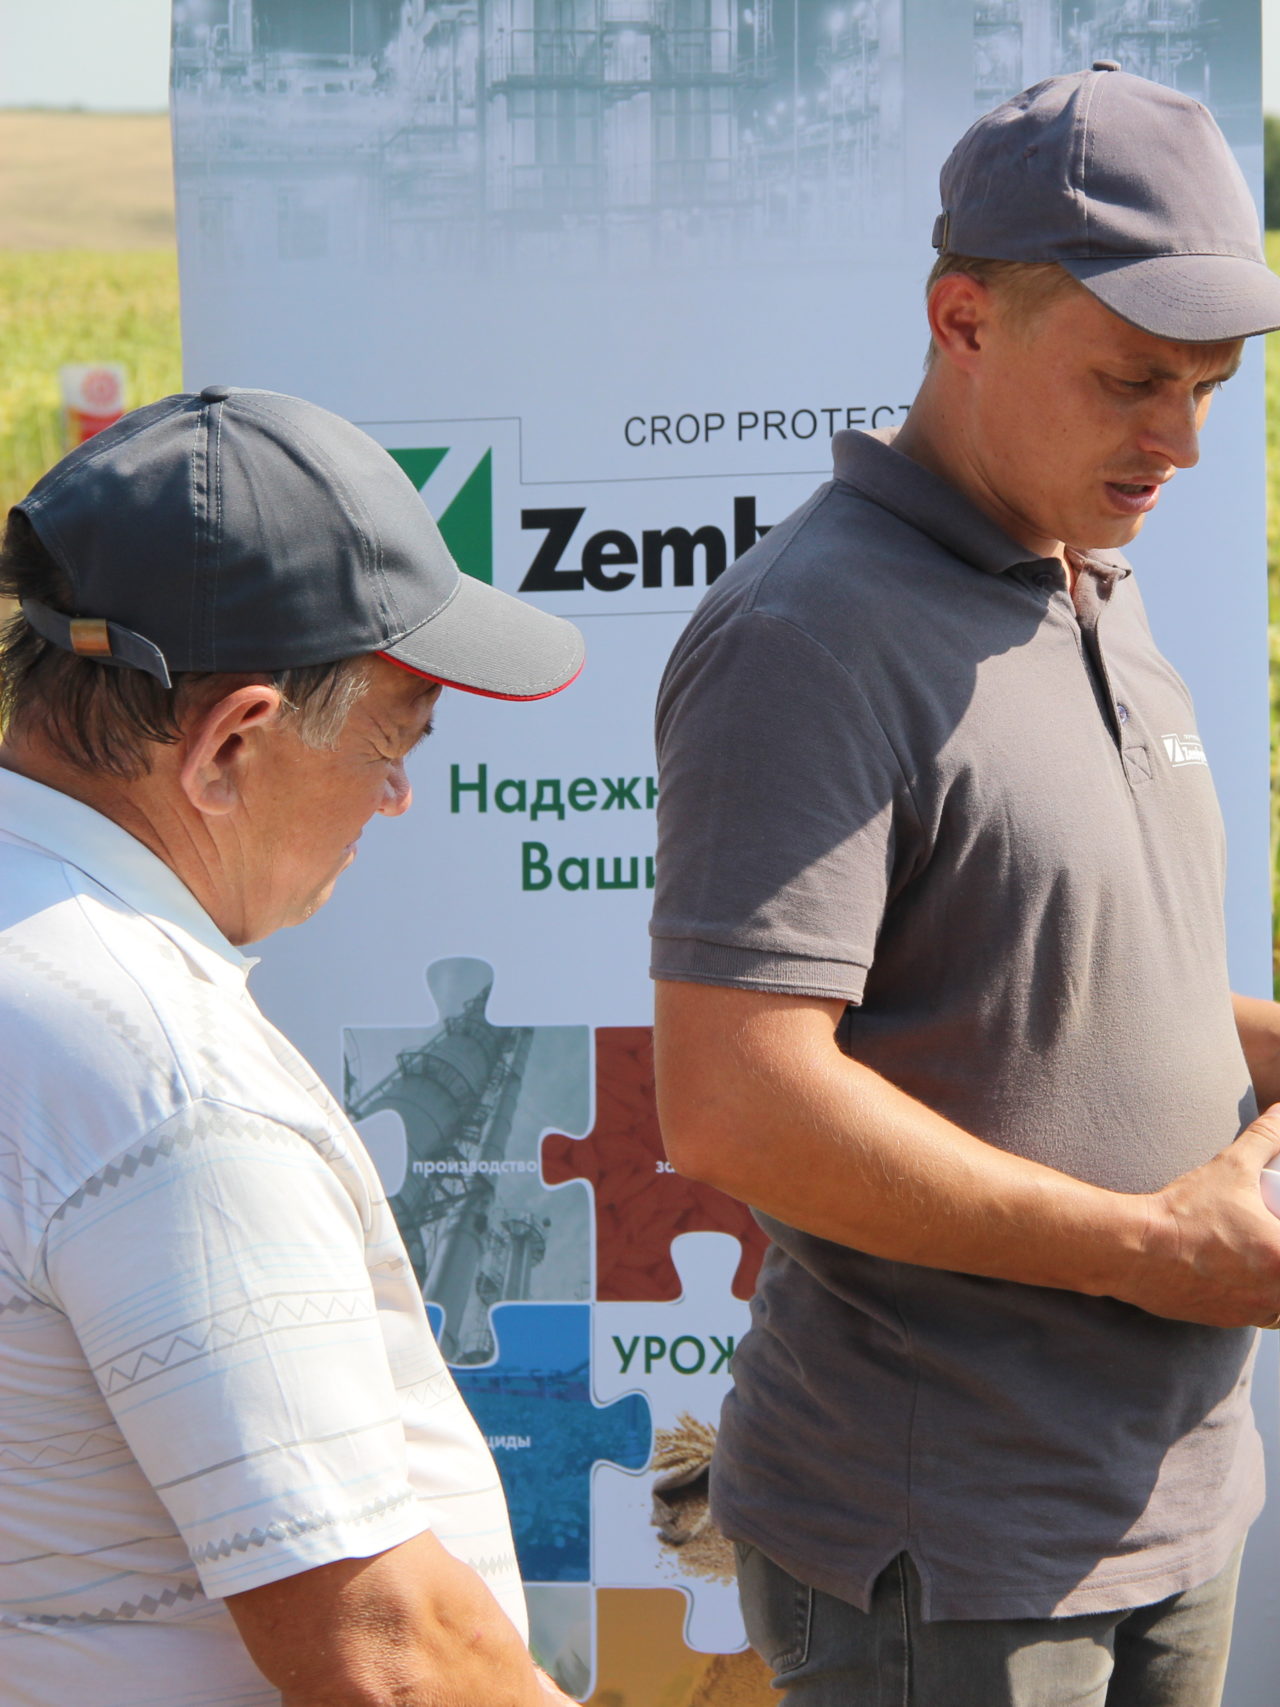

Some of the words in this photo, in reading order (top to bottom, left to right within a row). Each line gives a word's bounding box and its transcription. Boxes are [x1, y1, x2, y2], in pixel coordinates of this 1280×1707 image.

[624, 411, 726, 447] CROP
[517, 496, 774, 593] Zeml
[411, 1160, 538, 1176] производство
